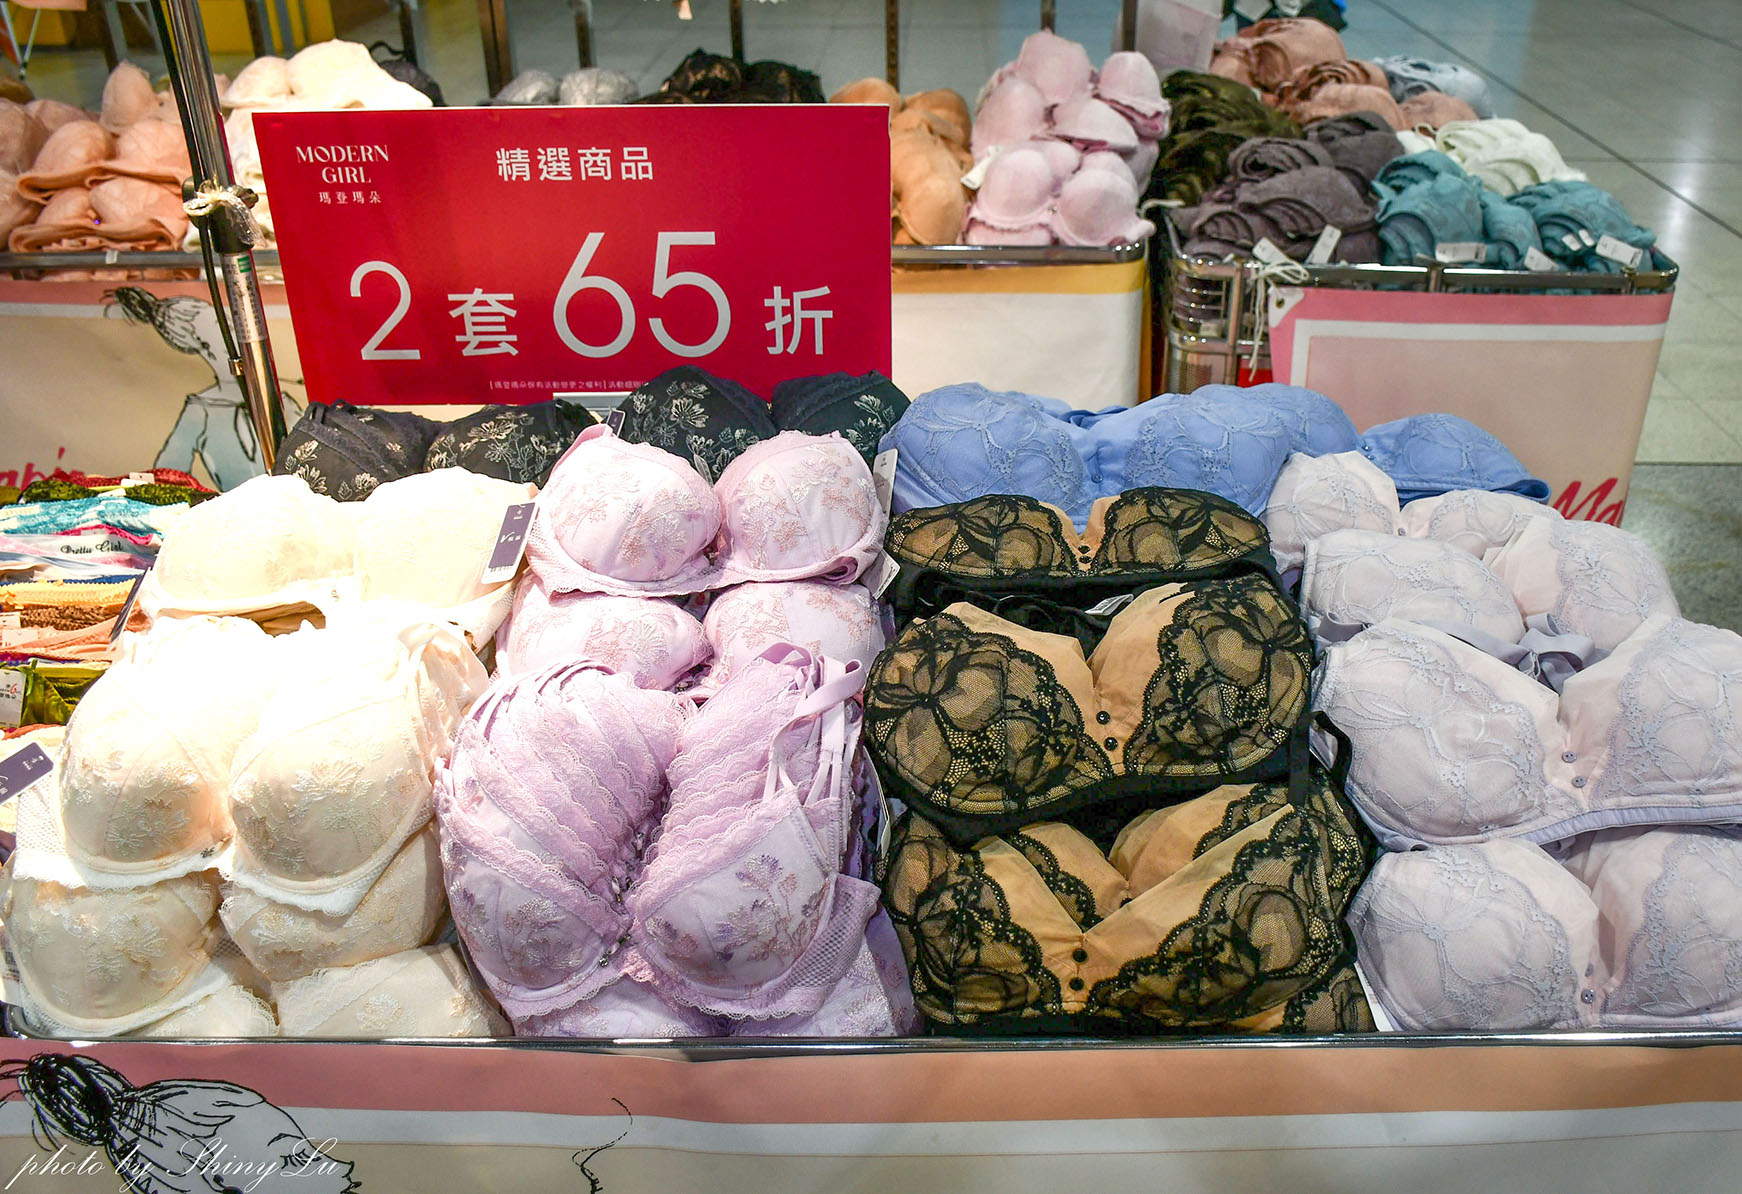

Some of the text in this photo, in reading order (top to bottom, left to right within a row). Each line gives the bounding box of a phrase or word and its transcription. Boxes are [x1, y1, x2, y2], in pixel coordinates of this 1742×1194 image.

[295, 144, 389, 164] MODERN
[495, 146, 655, 182] 精選商品
[321, 166, 372, 184] GIRL
[318, 190, 382, 205] 瑪登瑪朵
[349, 260, 421, 361] 2
[447, 287, 519, 357] 套
[552, 231, 731, 359] 65
[764, 286, 834, 356] 折
